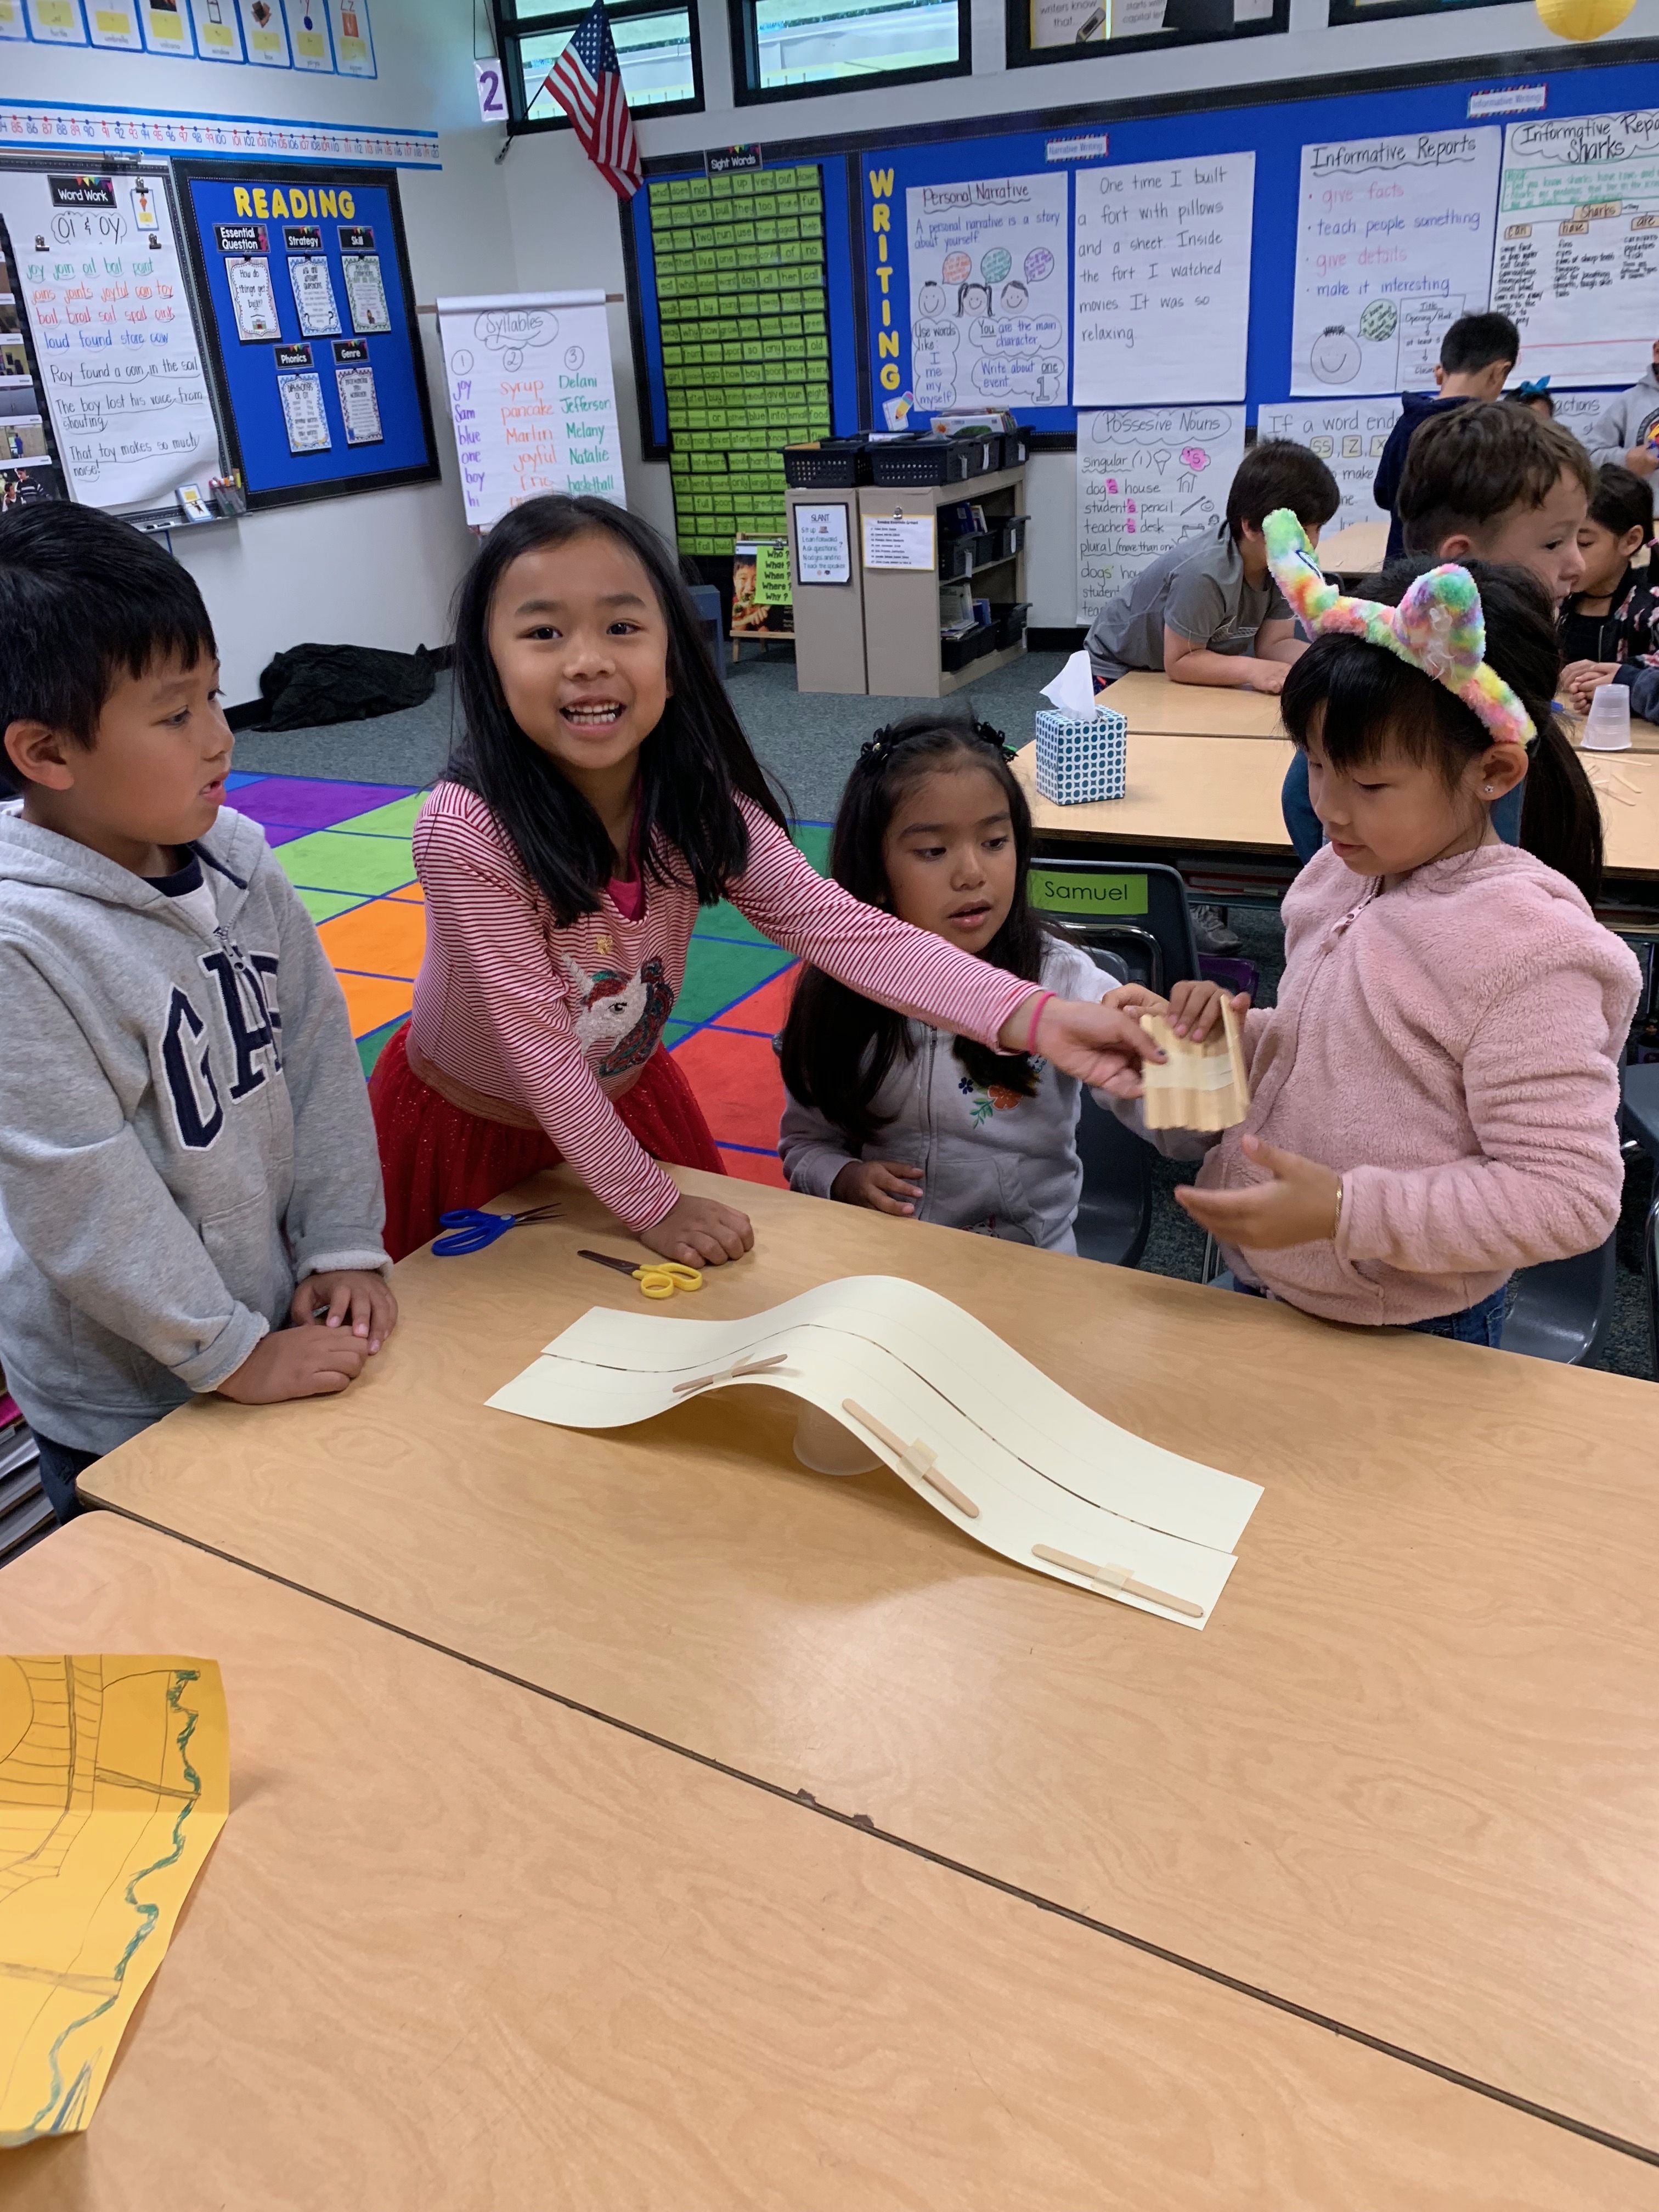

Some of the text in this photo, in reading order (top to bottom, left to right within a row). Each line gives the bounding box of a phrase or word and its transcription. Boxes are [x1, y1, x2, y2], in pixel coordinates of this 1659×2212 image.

[480, 71, 504, 111] 2
[11, 122, 226, 145] 85 86 87 88 90 92 97 100
[1521, 119, 1611, 145] Informative
[1311, 134, 1476, 169] Informative Reports
[1568, 135, 1624, 163] Sharks
[711, 156, 756, 171] Sight Words
[1100, 166, 1227, 194] One time built
[58, 189, 109, 202] Word Work
[233, 187, 355, 219] READING
[923, 179, 1029, 207] Personal Narrative
[1323, 181, 1404, 214] give facts
[929, 208, 1060, 234] personal narrative story
[1102, 198, 1223, 224] fort with pillows
[1582, 204, 1615, 219] Sharks
[220, 227, 255, 238] Essential
[1317, 209, 1480, 238] teach people something
[222, 239, 258, 250] Question
[288, 236, 319, 247] Strategy
[351, 236, 364, 245] Skill
[915, 235, 939, 250] about
[1079, 230, 1222, 257] and a Inside
[26, 256, 154, 281] joy boil point
[1080, 259, 1221, 283] the fort watched
[1317, 247, 1407, 277] give details
[101, 280, 173, 303] joyful toy
[1317, 276, 1449, 297] make it interesting
[1130, 293, 1149, 311] It
[1160, 296, 1184, 309] was
[1195, 296, 1210, 306] so
[36, 305, 116, 325] boil soil
[487, 310, 544, 343] Syllables
[915, 323, 956, 338] Use words
[978, 320, 1057, 335] You the main
[44, 332, 70, 349] loud
[79, 330, 112, 348] found
[150, 332, 168, 346] cow
[281, 354, 307, 364] Phonics
[341, 349, 361, 358] Genre
[50, 356, 199, 386] Roy found the soil
[926, 368, 943, 377] me
[981, 360, 1058, 375] Write about one
[453, 379, 472, 402] joy
[500, 379, 544, 402] syrup
[558, 373, 597, 390] Delani
[926, 381, 941, 391] my
[56, 387, 204, 416] The boy lost his voice from
[559, 396, 611, 414] Jefferson
[920, 390, 951, 409] myself
[455, 404, 476, 422] Sam
[501, 399, 554, 425] pancake
[1103, 410, 1221, 433] Possesive Nouns
[1268, 414, 1293, 433] If
[1303, 420, 1313, 433] a
[1323, 410, 1358, 430] word
[63, 416, 105, 432] shouting
[566, 422, 605, 444] Melany
[458, 425, 481, 445] blue
[69, 431, 198, 462] That toy makes much
[569, 445, 610, 465] Natalie
[461, 451, 482, 464] one
[514, 444, 557, 472] joyful
[1083, 453, 1128, 473] singular
[73, 460, 100, 477] noise!
[1343, 465, 1374, 479] make
[465, 467, 485, 492] boy
[467, 490, 479, 506] hi
[1086, 479, 1161, 501] dog's house
[1084, 499, 1173, 519] student's pencil
[1084, 518, 1164, 533] teacher's desk
[768, 550, 783, 559] Who
[1080, 538, 1138, 560] plural (more
[765, 561, 785, 569] What
[764, 571, 785, 580] When
[762, 582, 786, 590] Where
[766, 592, 781, 602] Why
[1045, 881, 1127, 900] Samuel
